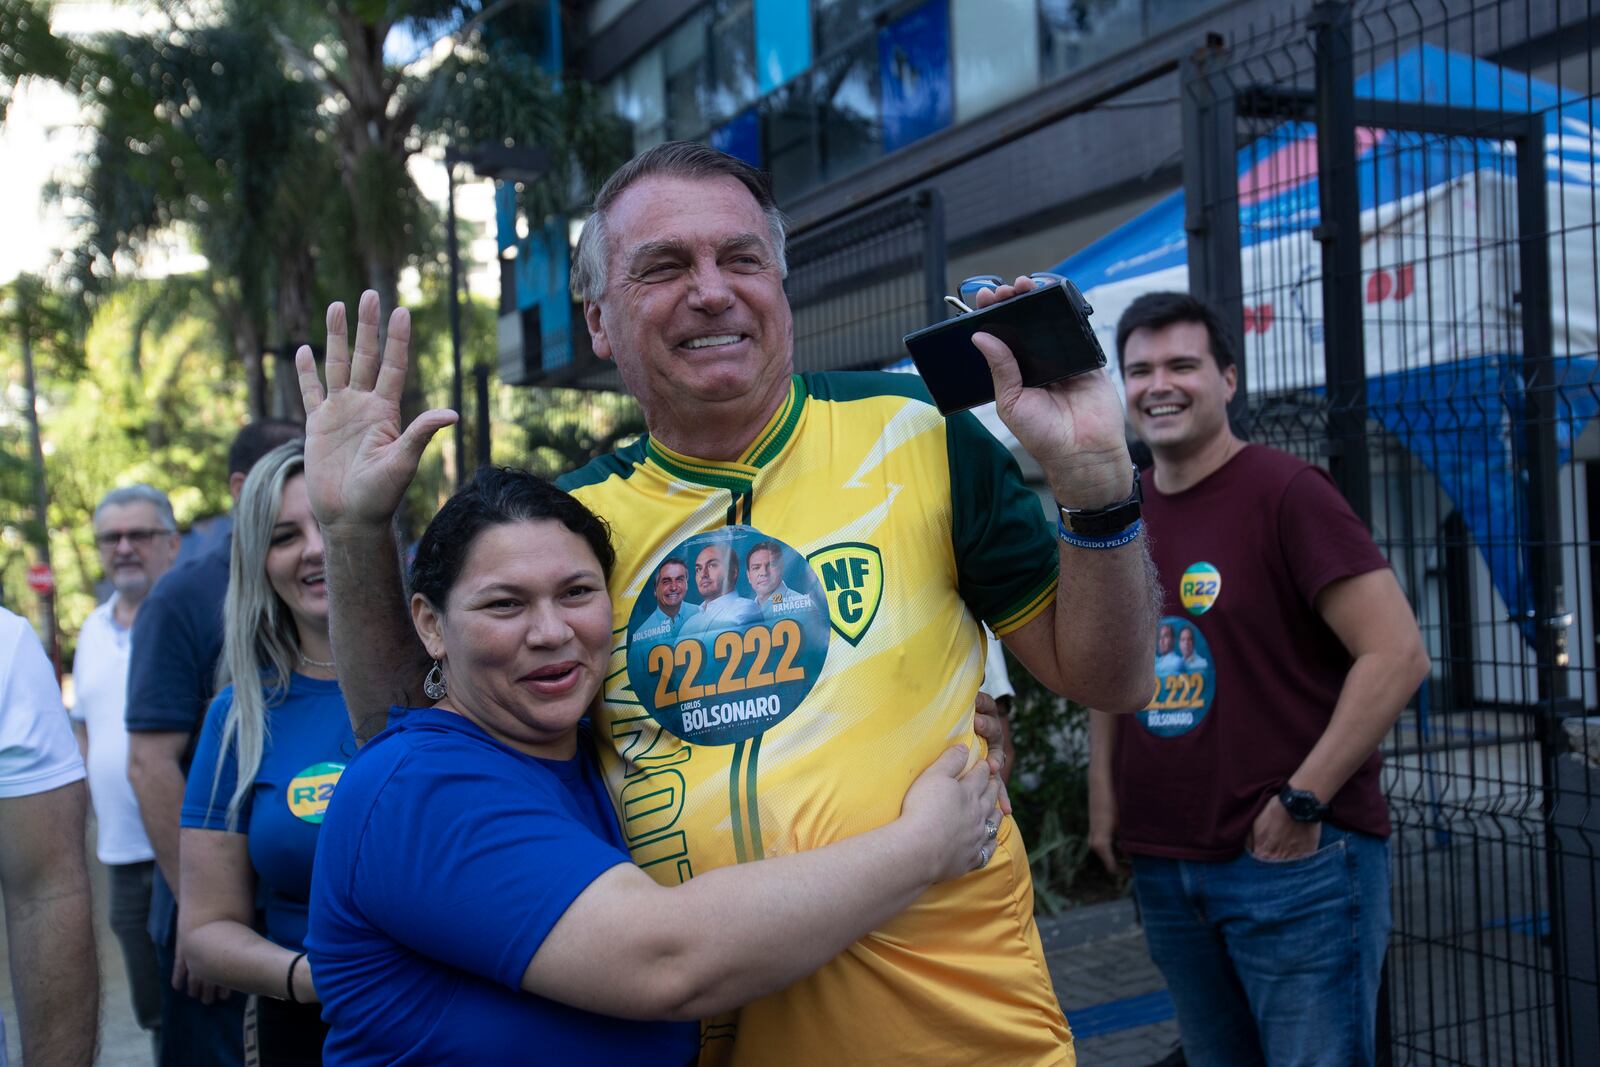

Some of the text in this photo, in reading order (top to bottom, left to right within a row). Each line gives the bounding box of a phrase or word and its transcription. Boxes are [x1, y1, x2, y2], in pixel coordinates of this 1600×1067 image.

[1106, 536, 1129, 548] PELO
[820, 557, 869, 592] NF
[1183, 580, 1217, 597] R22
[837, 589, 863, 624] C
[647, 619, 805, 709] 22.222
[680, 700, 702, 712] CARLOS
[682, 694, 781, 733] BOLSONARO
